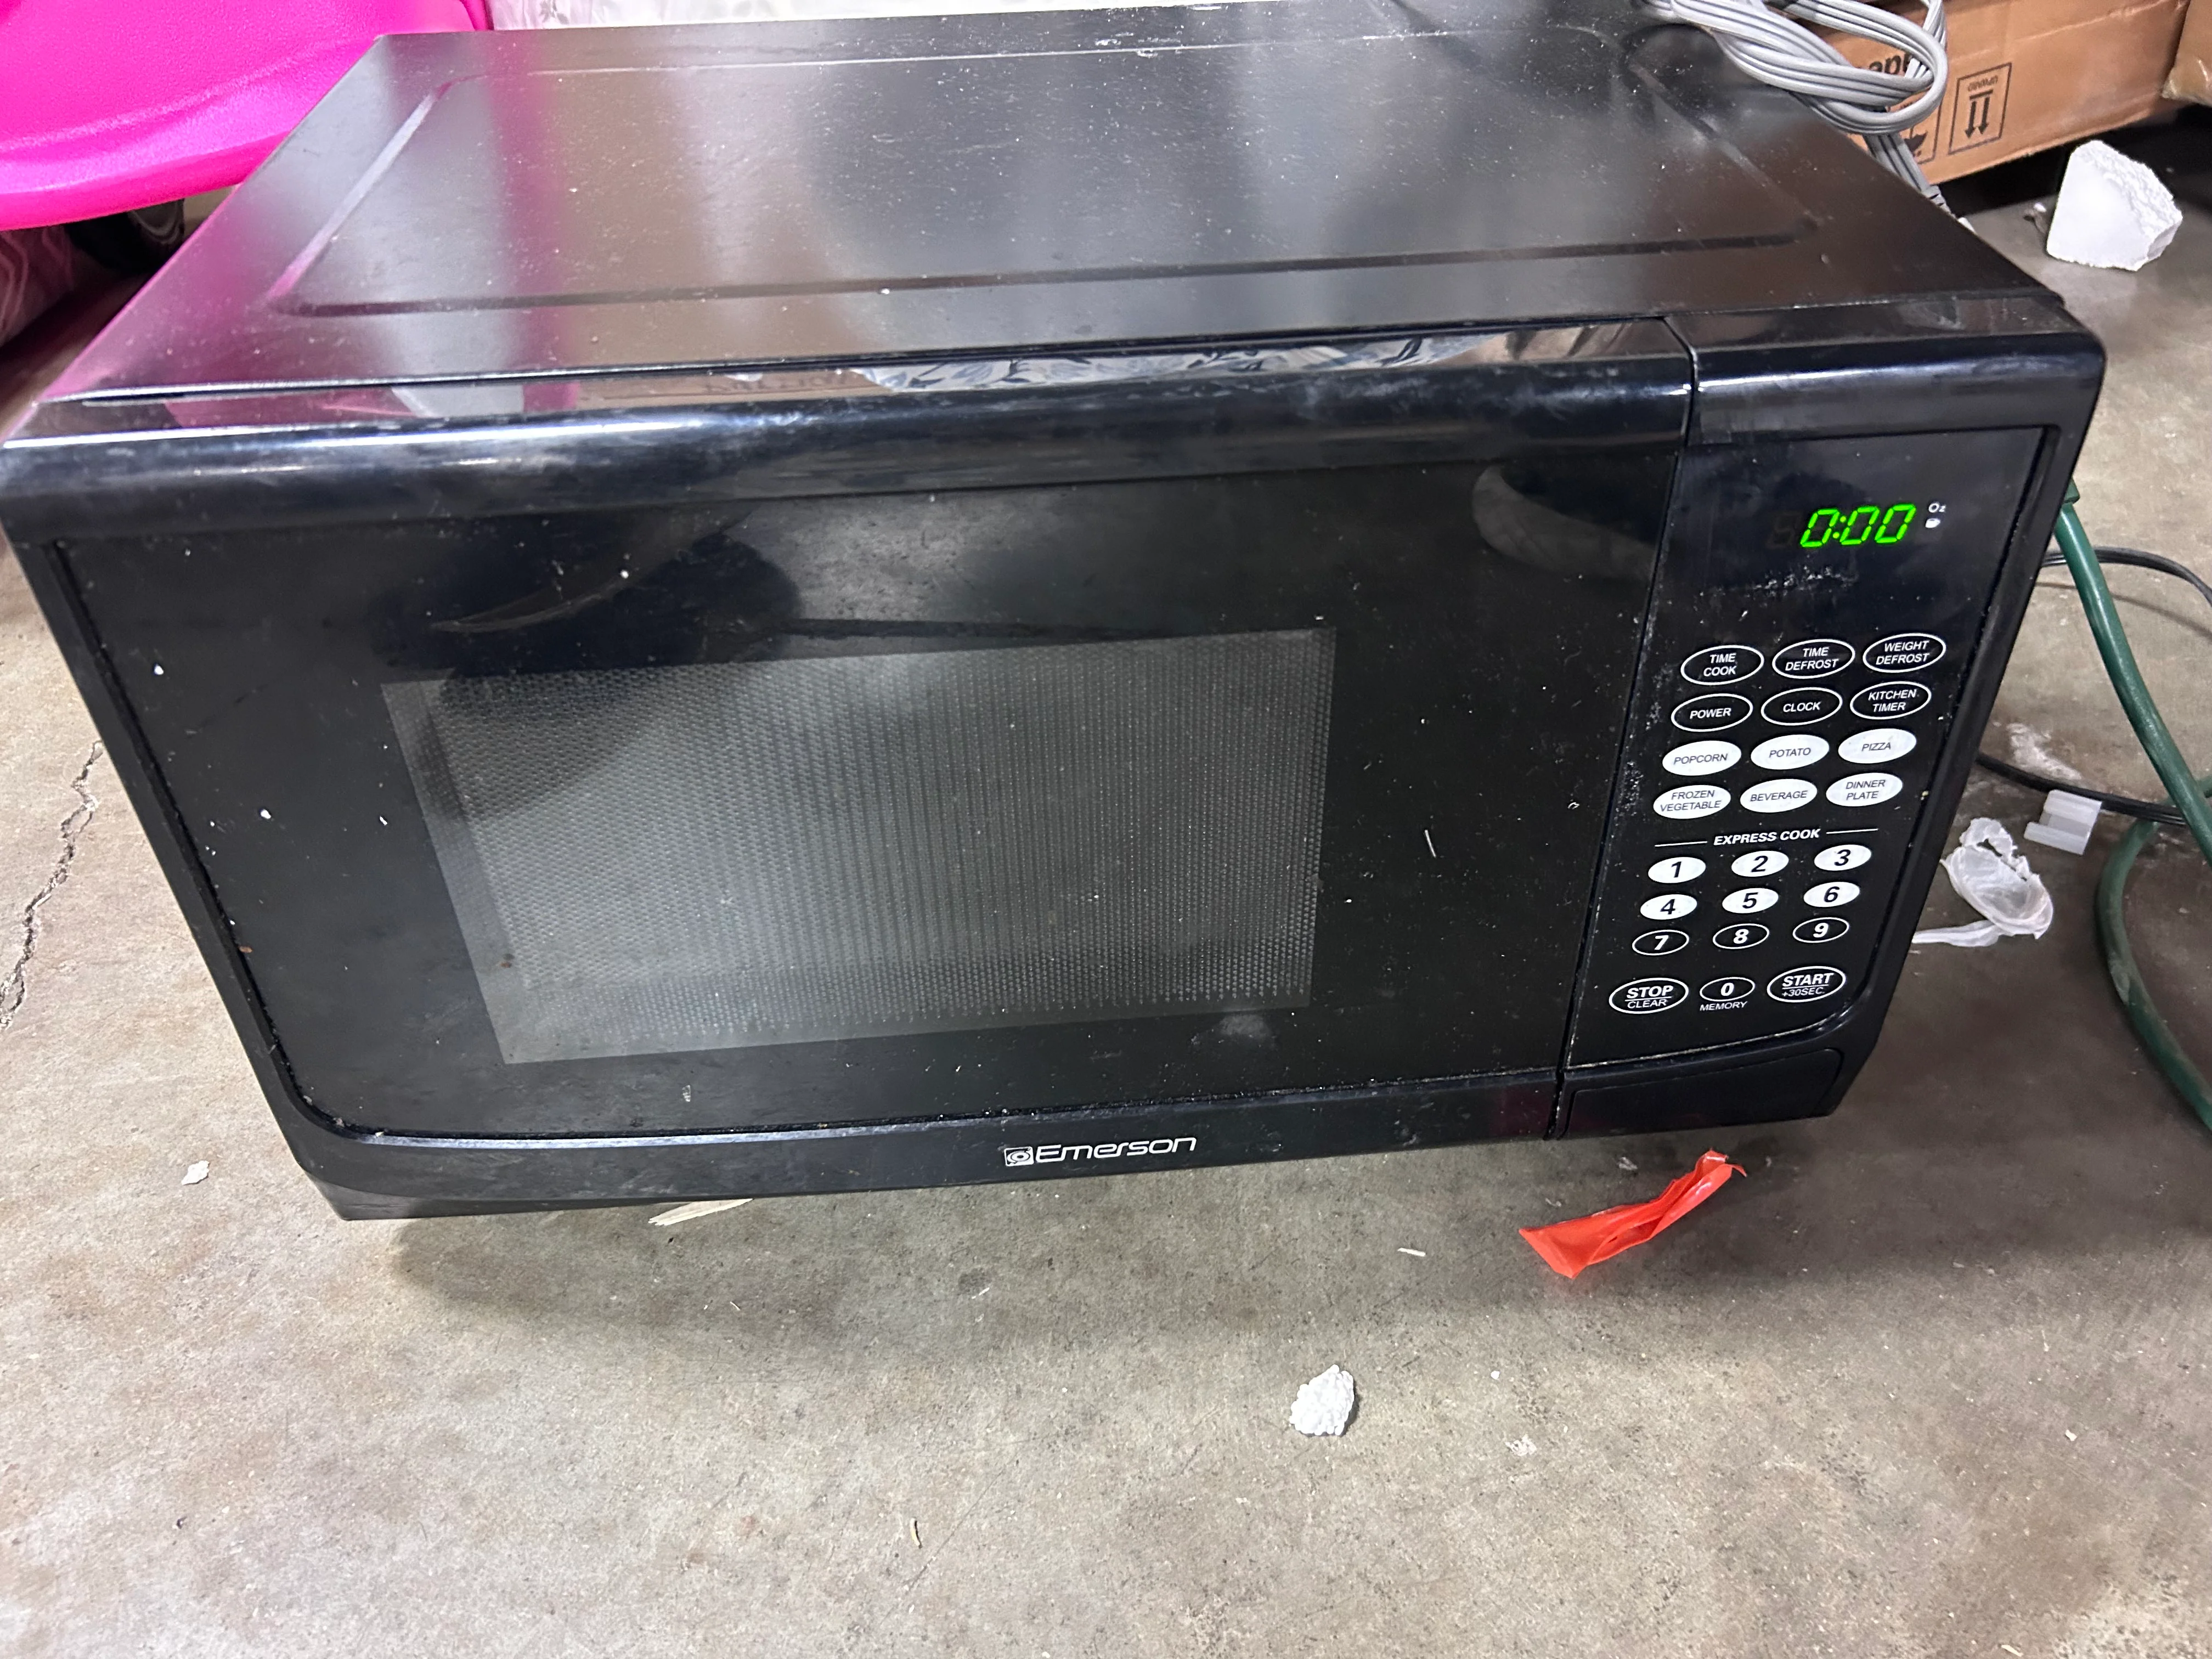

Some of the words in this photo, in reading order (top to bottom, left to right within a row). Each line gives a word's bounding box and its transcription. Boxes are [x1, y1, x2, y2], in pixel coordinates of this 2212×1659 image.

[1799, 504, 1917, 548] 0:00
[1803, 646, 1830, 657] TIME
[1884, 640, 1929, 652] WEIGHT
[1709, 652, 1737, 664] TIME
[1875, 652, 1931, 665] DEFROST
[1785, 658, 1839, 671] DEFROST
[1703, 665, 1737, 677] COOK
[1867, 689, 1917, 701] KITCHEN
[1689, 707, 1732, 719] POWER
[1782, 701, 1821, 713] CLOCK
[1872, 702, 1906, 713] TIMER
[1768, 747, 1812, 758] POTATO
[1861, 742, 1892, 752] PIZZA
[1673, 753, 1729, 765] POPCORN
[1845, 779, 1887, 789] DINNER
[1671, 789, 1715, 800] FROZEN
[1750, 790, 1808, 802] BEVERAGE
[1846, 791, 1880, 801] PLATE
[1660, 800, 1722, 812] VEGETABLE
[1713, 832, 1778, 846] EXPRESS
[1779, 828, 1820, 841] COOK
[1834, 849, 1851, 866] 3
[1671, 861, 1682, 878] 1
[1751, 855, 1768, 873] 2
[1742, 891, 1758, 909] 5
[1824, 886, 1840, 903] 6
[1660, 899, 1676, 915] 4
[1733, 928, 1750, 944] 8
[1813, 922, 1829, 938] 9
[1654, 935, 1669, 950] 7
[1782, 973, 1834, 987] START
[1626, 985, 1673, 998] STOP
[1720, 982, 1735, 996] 0
[1627, 998, 1668, 1009] CLEAR
[1700, 1001, 1748, 1012] MEMORY
[1035, 1137, 1197, 1163] Emerson
